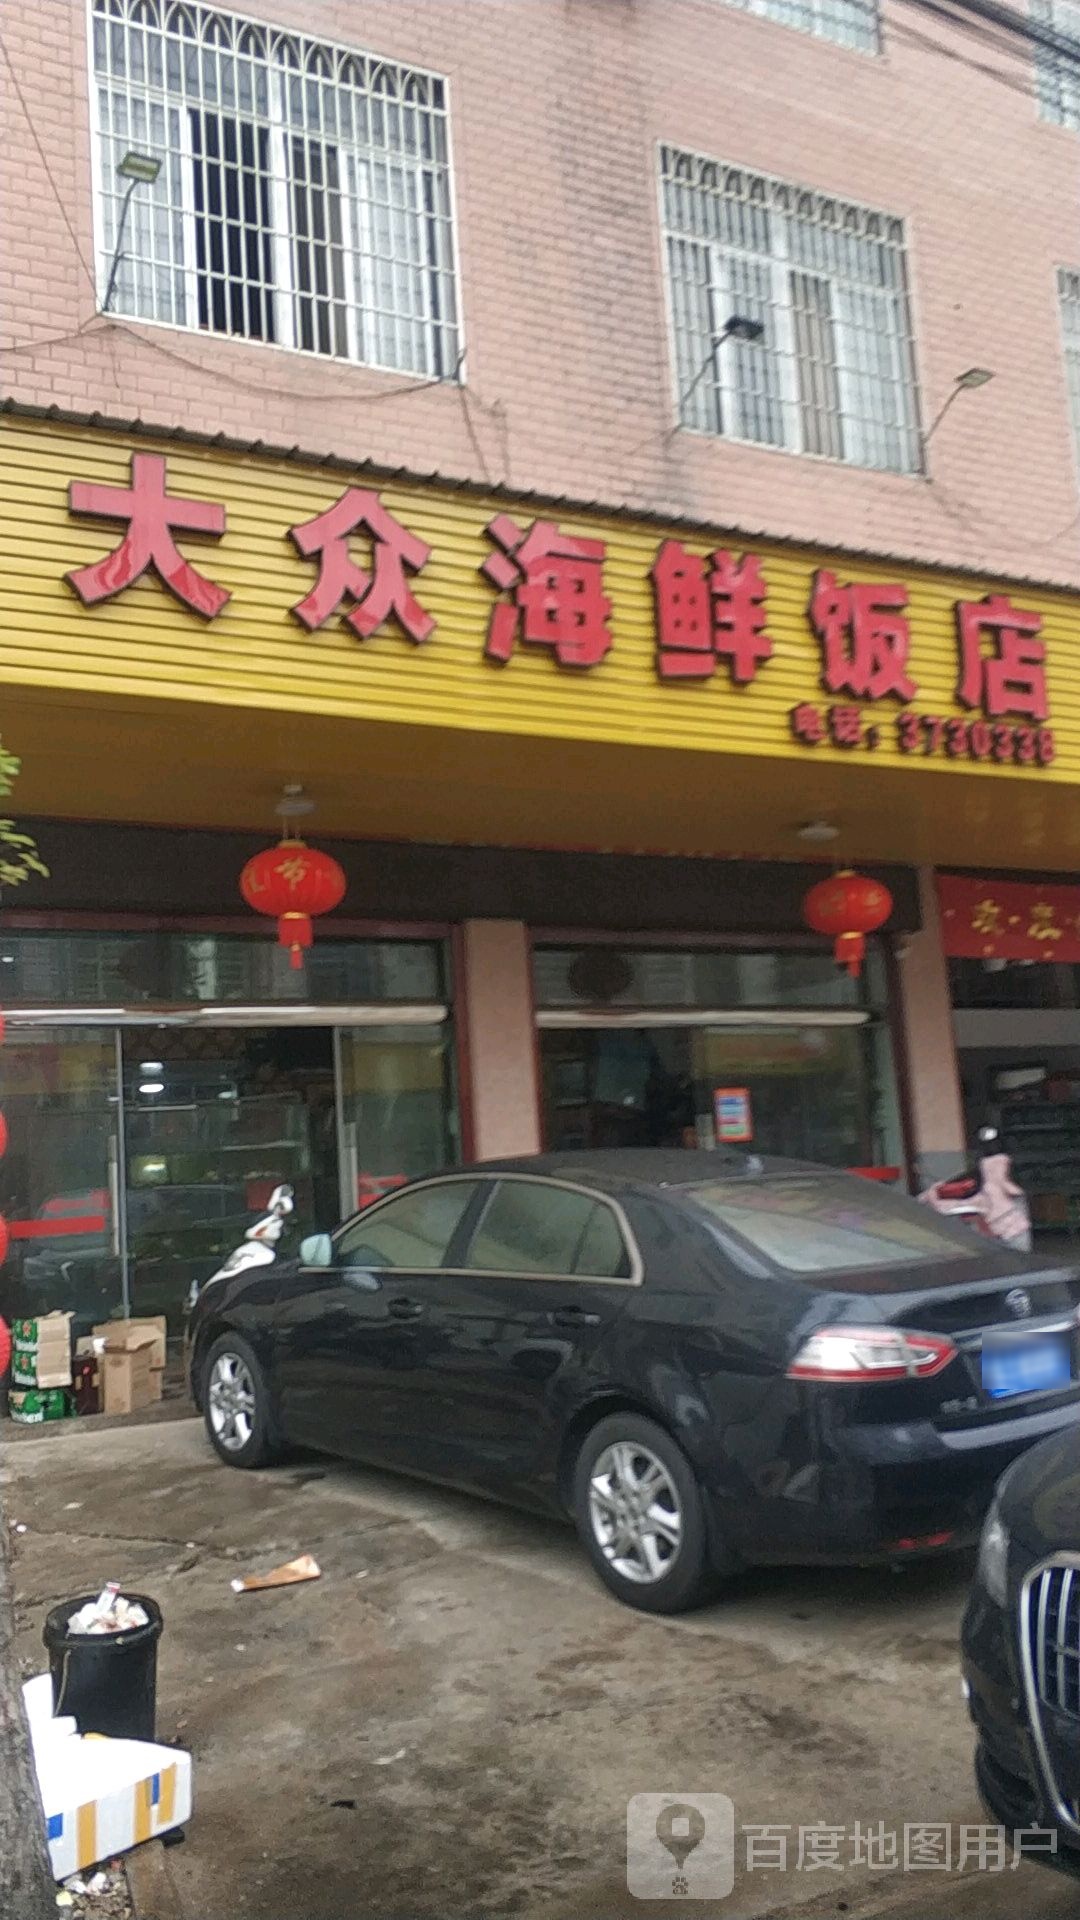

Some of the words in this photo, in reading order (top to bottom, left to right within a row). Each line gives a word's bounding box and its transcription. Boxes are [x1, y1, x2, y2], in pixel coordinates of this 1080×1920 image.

[65, 452, 1049, 720] 大众海鲜饭店
